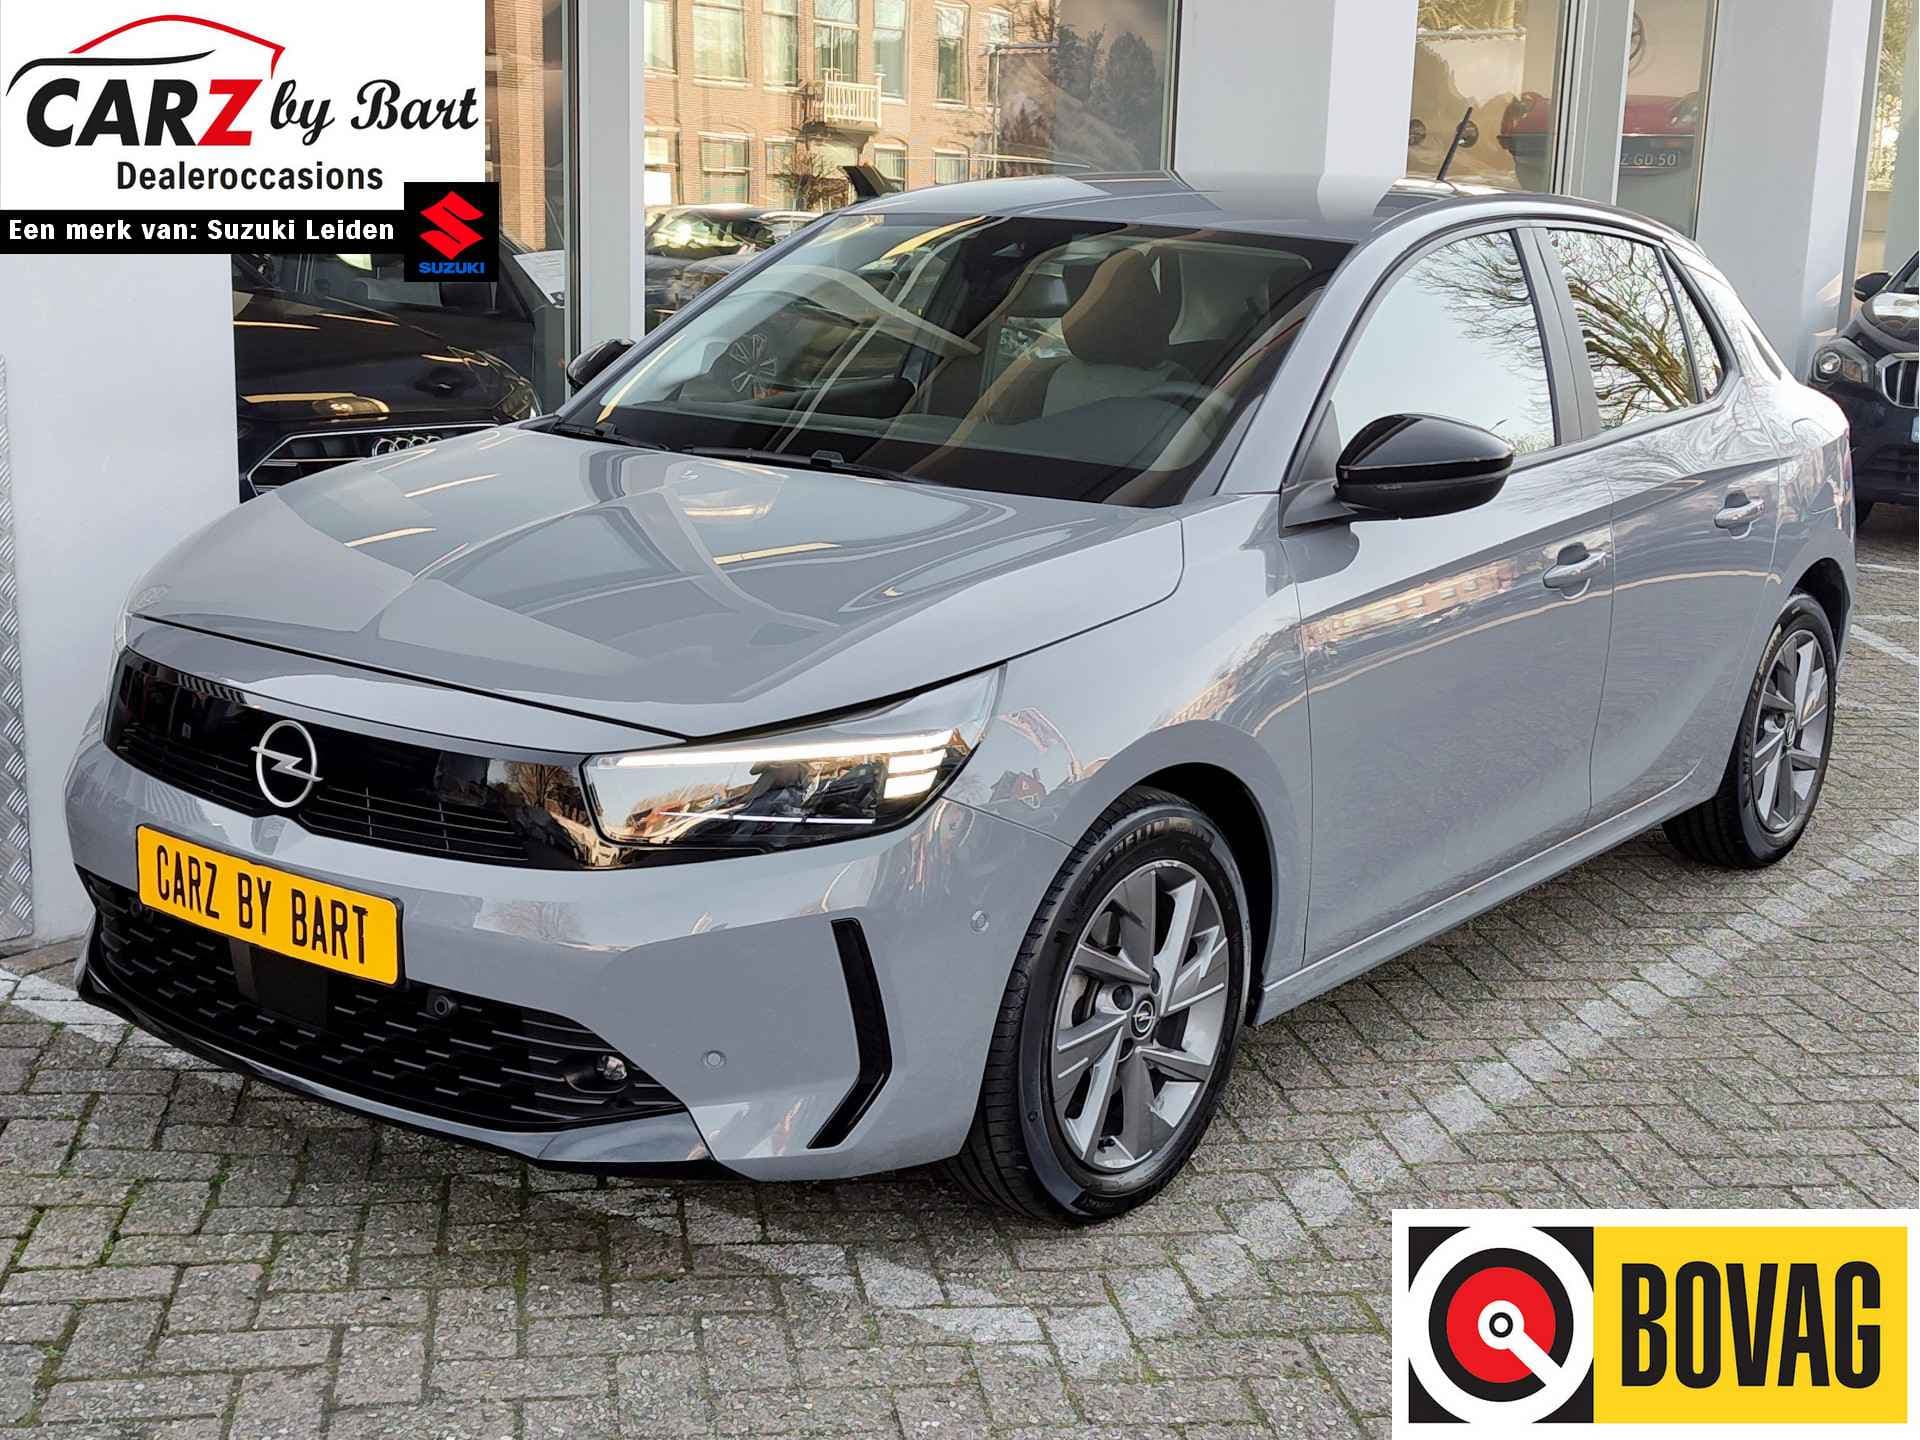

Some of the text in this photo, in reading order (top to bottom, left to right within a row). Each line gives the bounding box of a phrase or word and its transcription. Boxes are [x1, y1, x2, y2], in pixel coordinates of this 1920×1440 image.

[157, 845, 369, 963] CARZ BY BART
